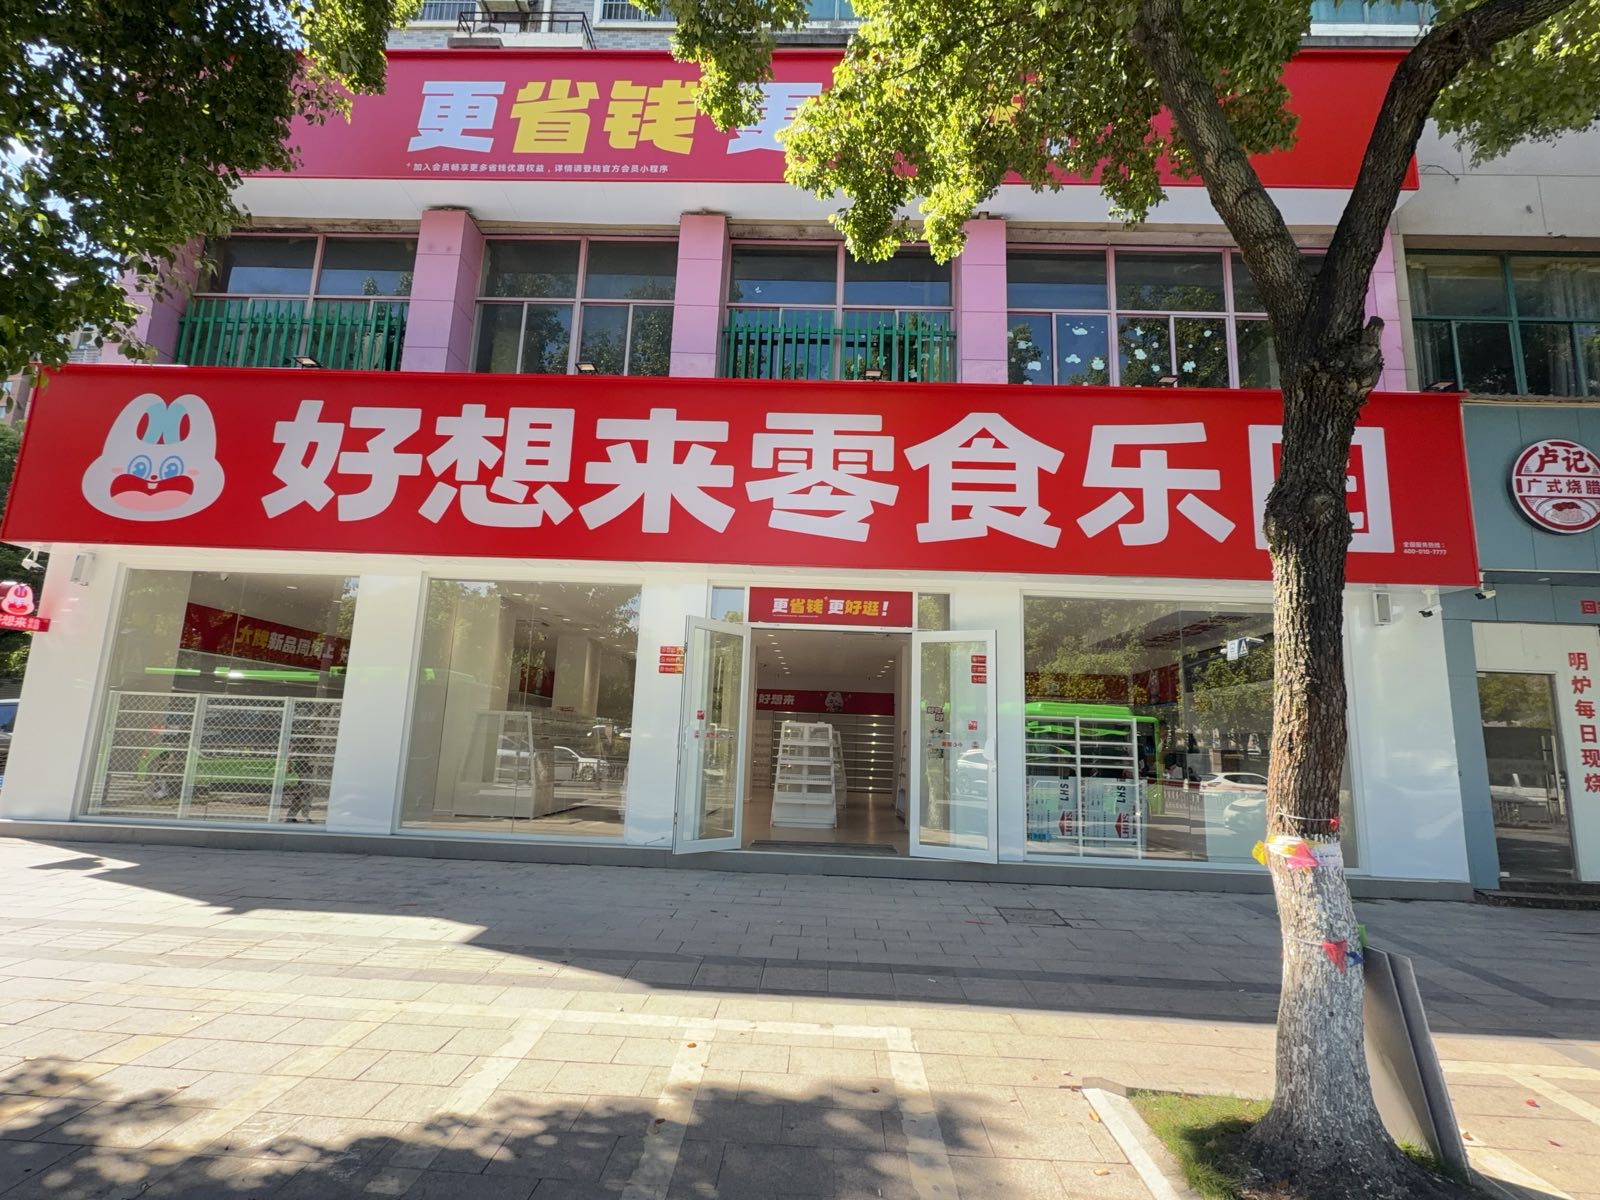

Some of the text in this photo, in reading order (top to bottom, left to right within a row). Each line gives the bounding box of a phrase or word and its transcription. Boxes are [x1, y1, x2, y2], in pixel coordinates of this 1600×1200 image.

[1535, 446, 1591, 473] 卢记
[1527, 478, 1600, 495] 广式烧腊
